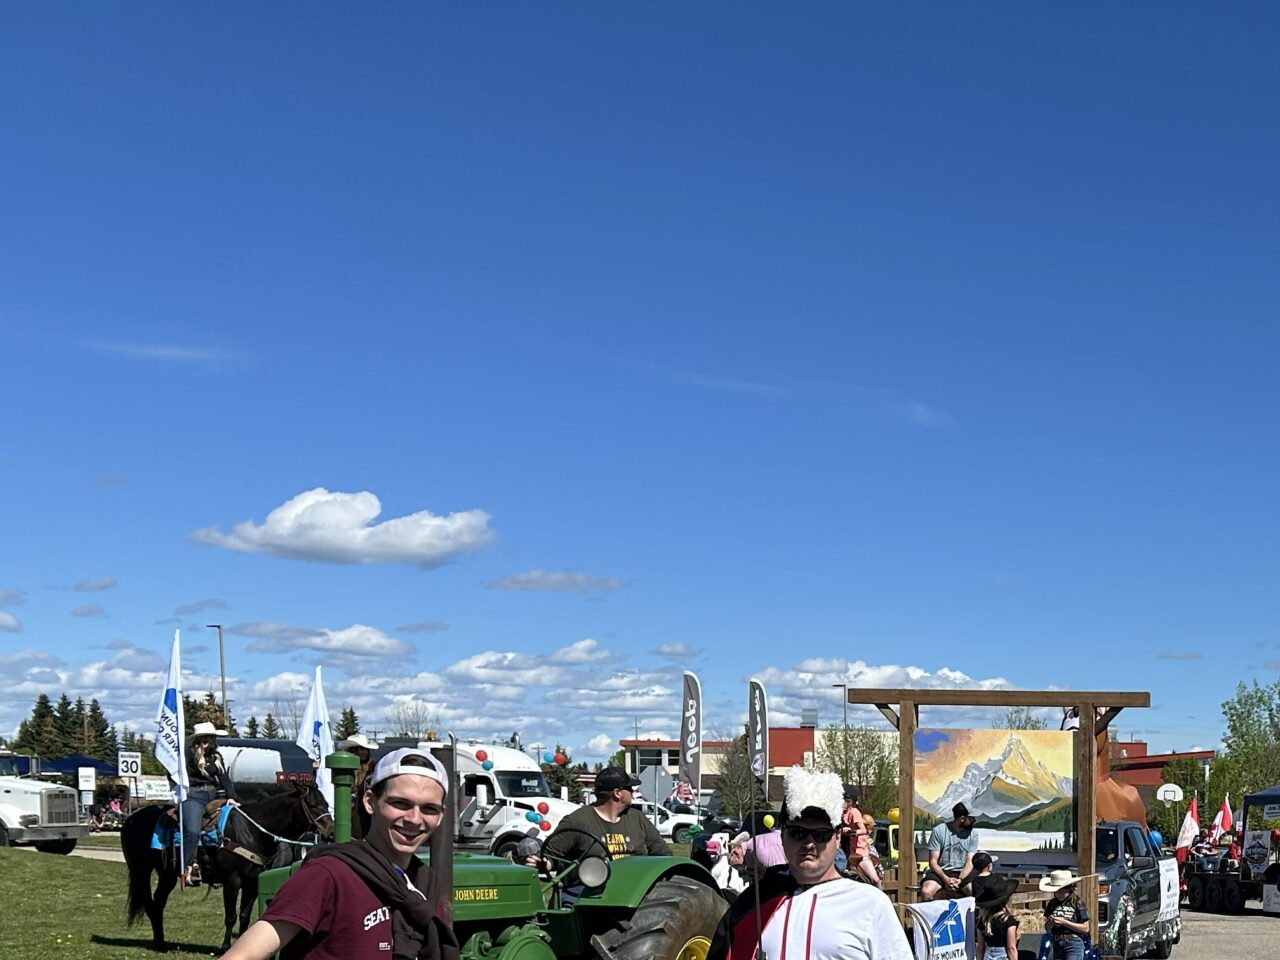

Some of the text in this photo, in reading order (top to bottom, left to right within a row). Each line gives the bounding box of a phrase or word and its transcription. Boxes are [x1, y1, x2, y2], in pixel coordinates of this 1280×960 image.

[121, 761, 139, 774] 30
[606, 833, 625, 844] EARN
[454, 889, 498, 901] JOHN DEERE
[363, 906, 390, 931] SEAT
